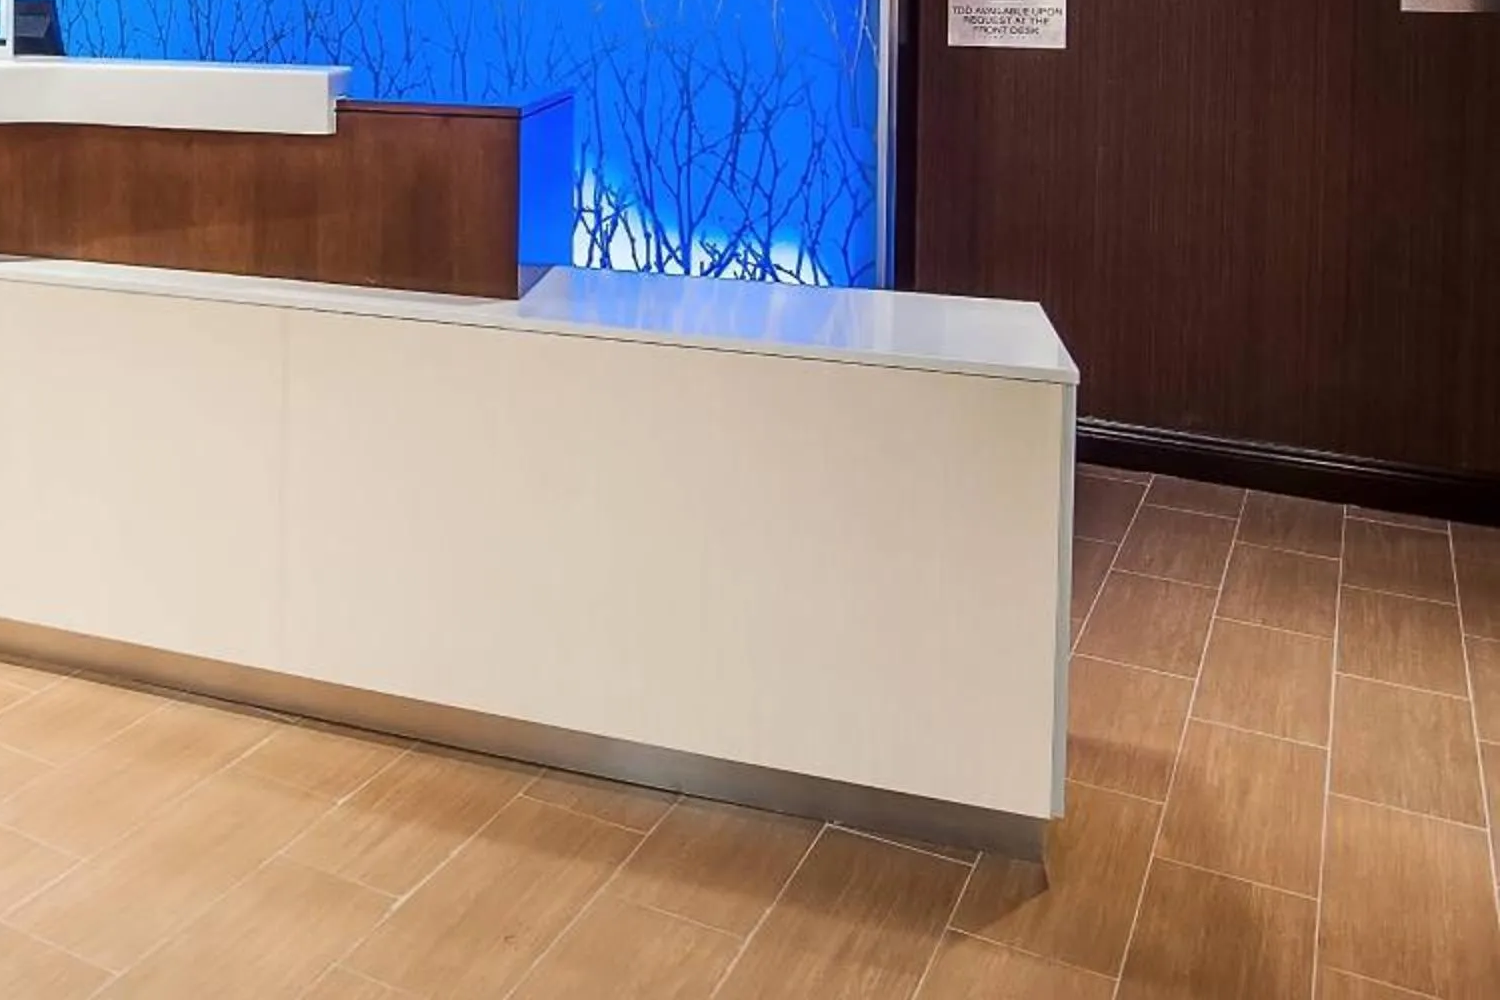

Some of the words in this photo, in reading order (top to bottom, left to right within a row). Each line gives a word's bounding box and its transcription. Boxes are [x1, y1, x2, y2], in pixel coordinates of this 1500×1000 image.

[975, 6, 1030, 16] AVAILABLE
[1031, 7, 1063, 17] UPON
[963, 15, 1012, 25] REQUEST
[973, 25, 1008, 35] FRONT
[1009, 25, 1040, 35] DESK
